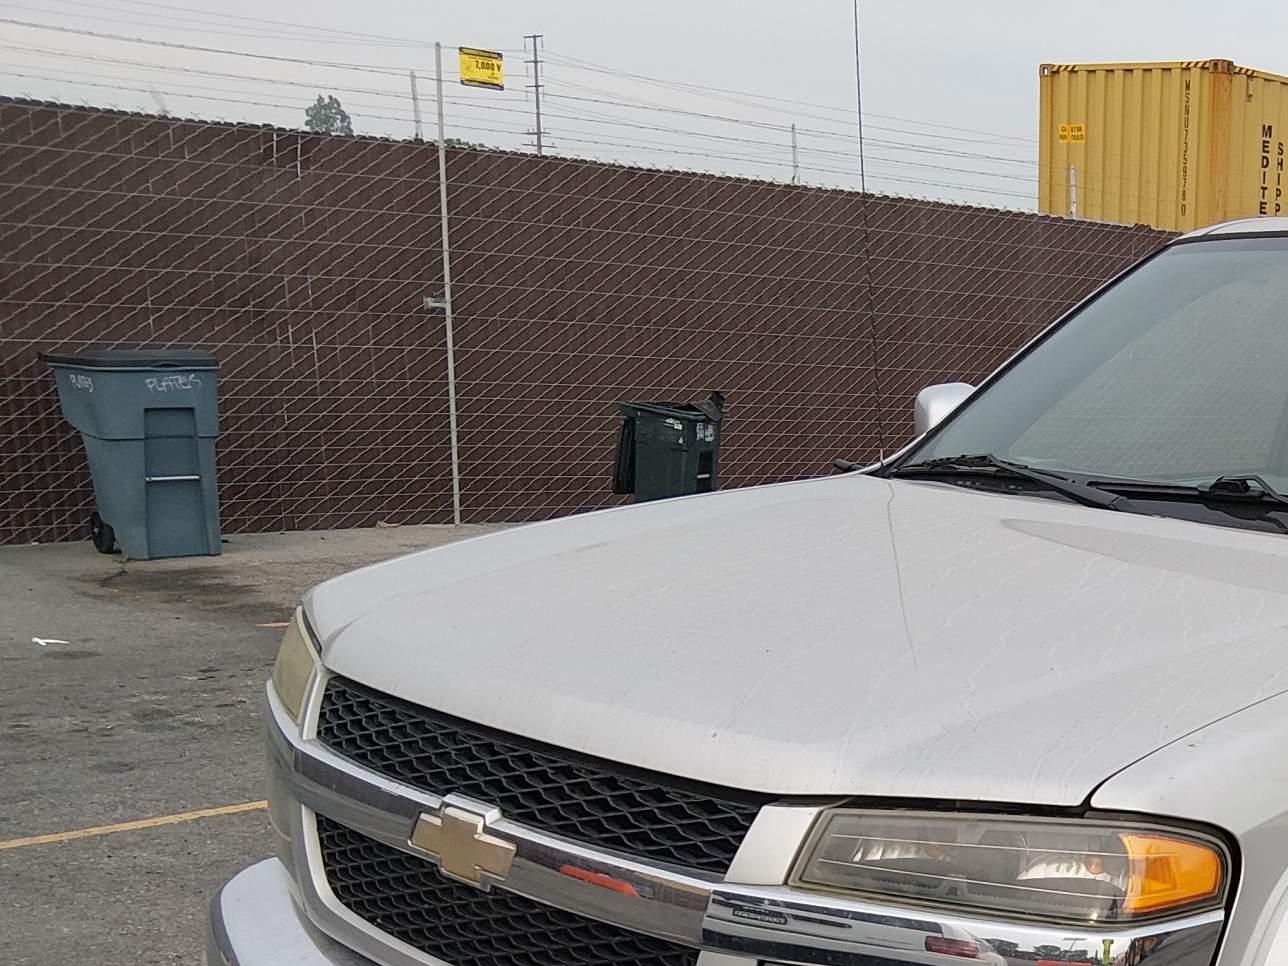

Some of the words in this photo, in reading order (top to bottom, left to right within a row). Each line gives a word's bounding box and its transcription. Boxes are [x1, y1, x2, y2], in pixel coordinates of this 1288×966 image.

[475, 60, 495, 71] 7,000
[1259, 124, 1273, 216] MEDITE
[144, 373, 203, 392] PLATES
